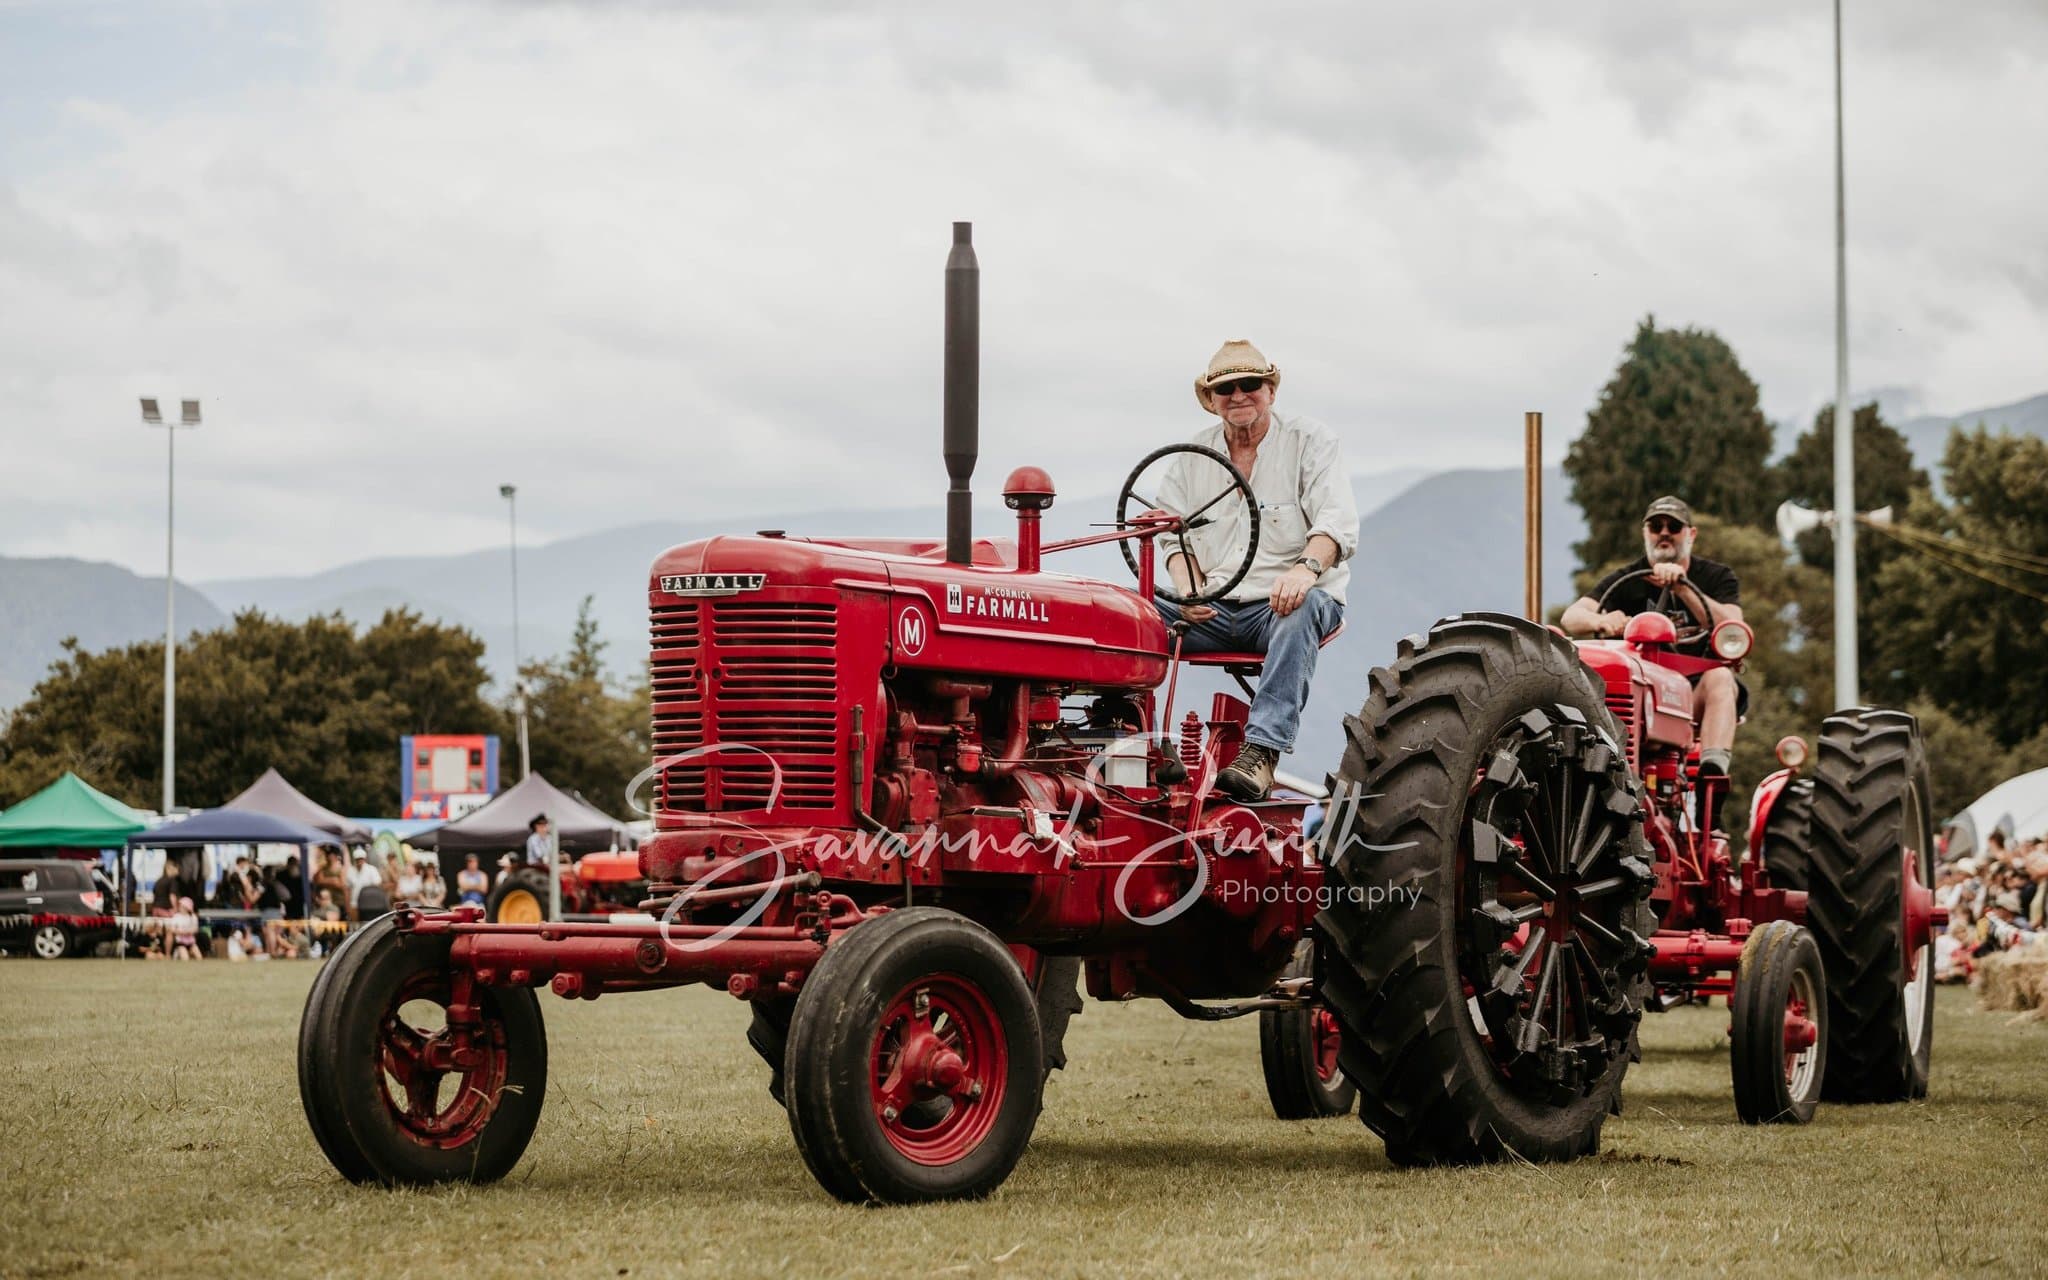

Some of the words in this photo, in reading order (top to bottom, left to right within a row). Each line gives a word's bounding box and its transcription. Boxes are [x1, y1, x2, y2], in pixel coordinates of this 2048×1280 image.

[664, 576, 757, 590] FARMALL
[966, 596, 1049, 623] FARMALL
[904, 618, 920, 646] M
